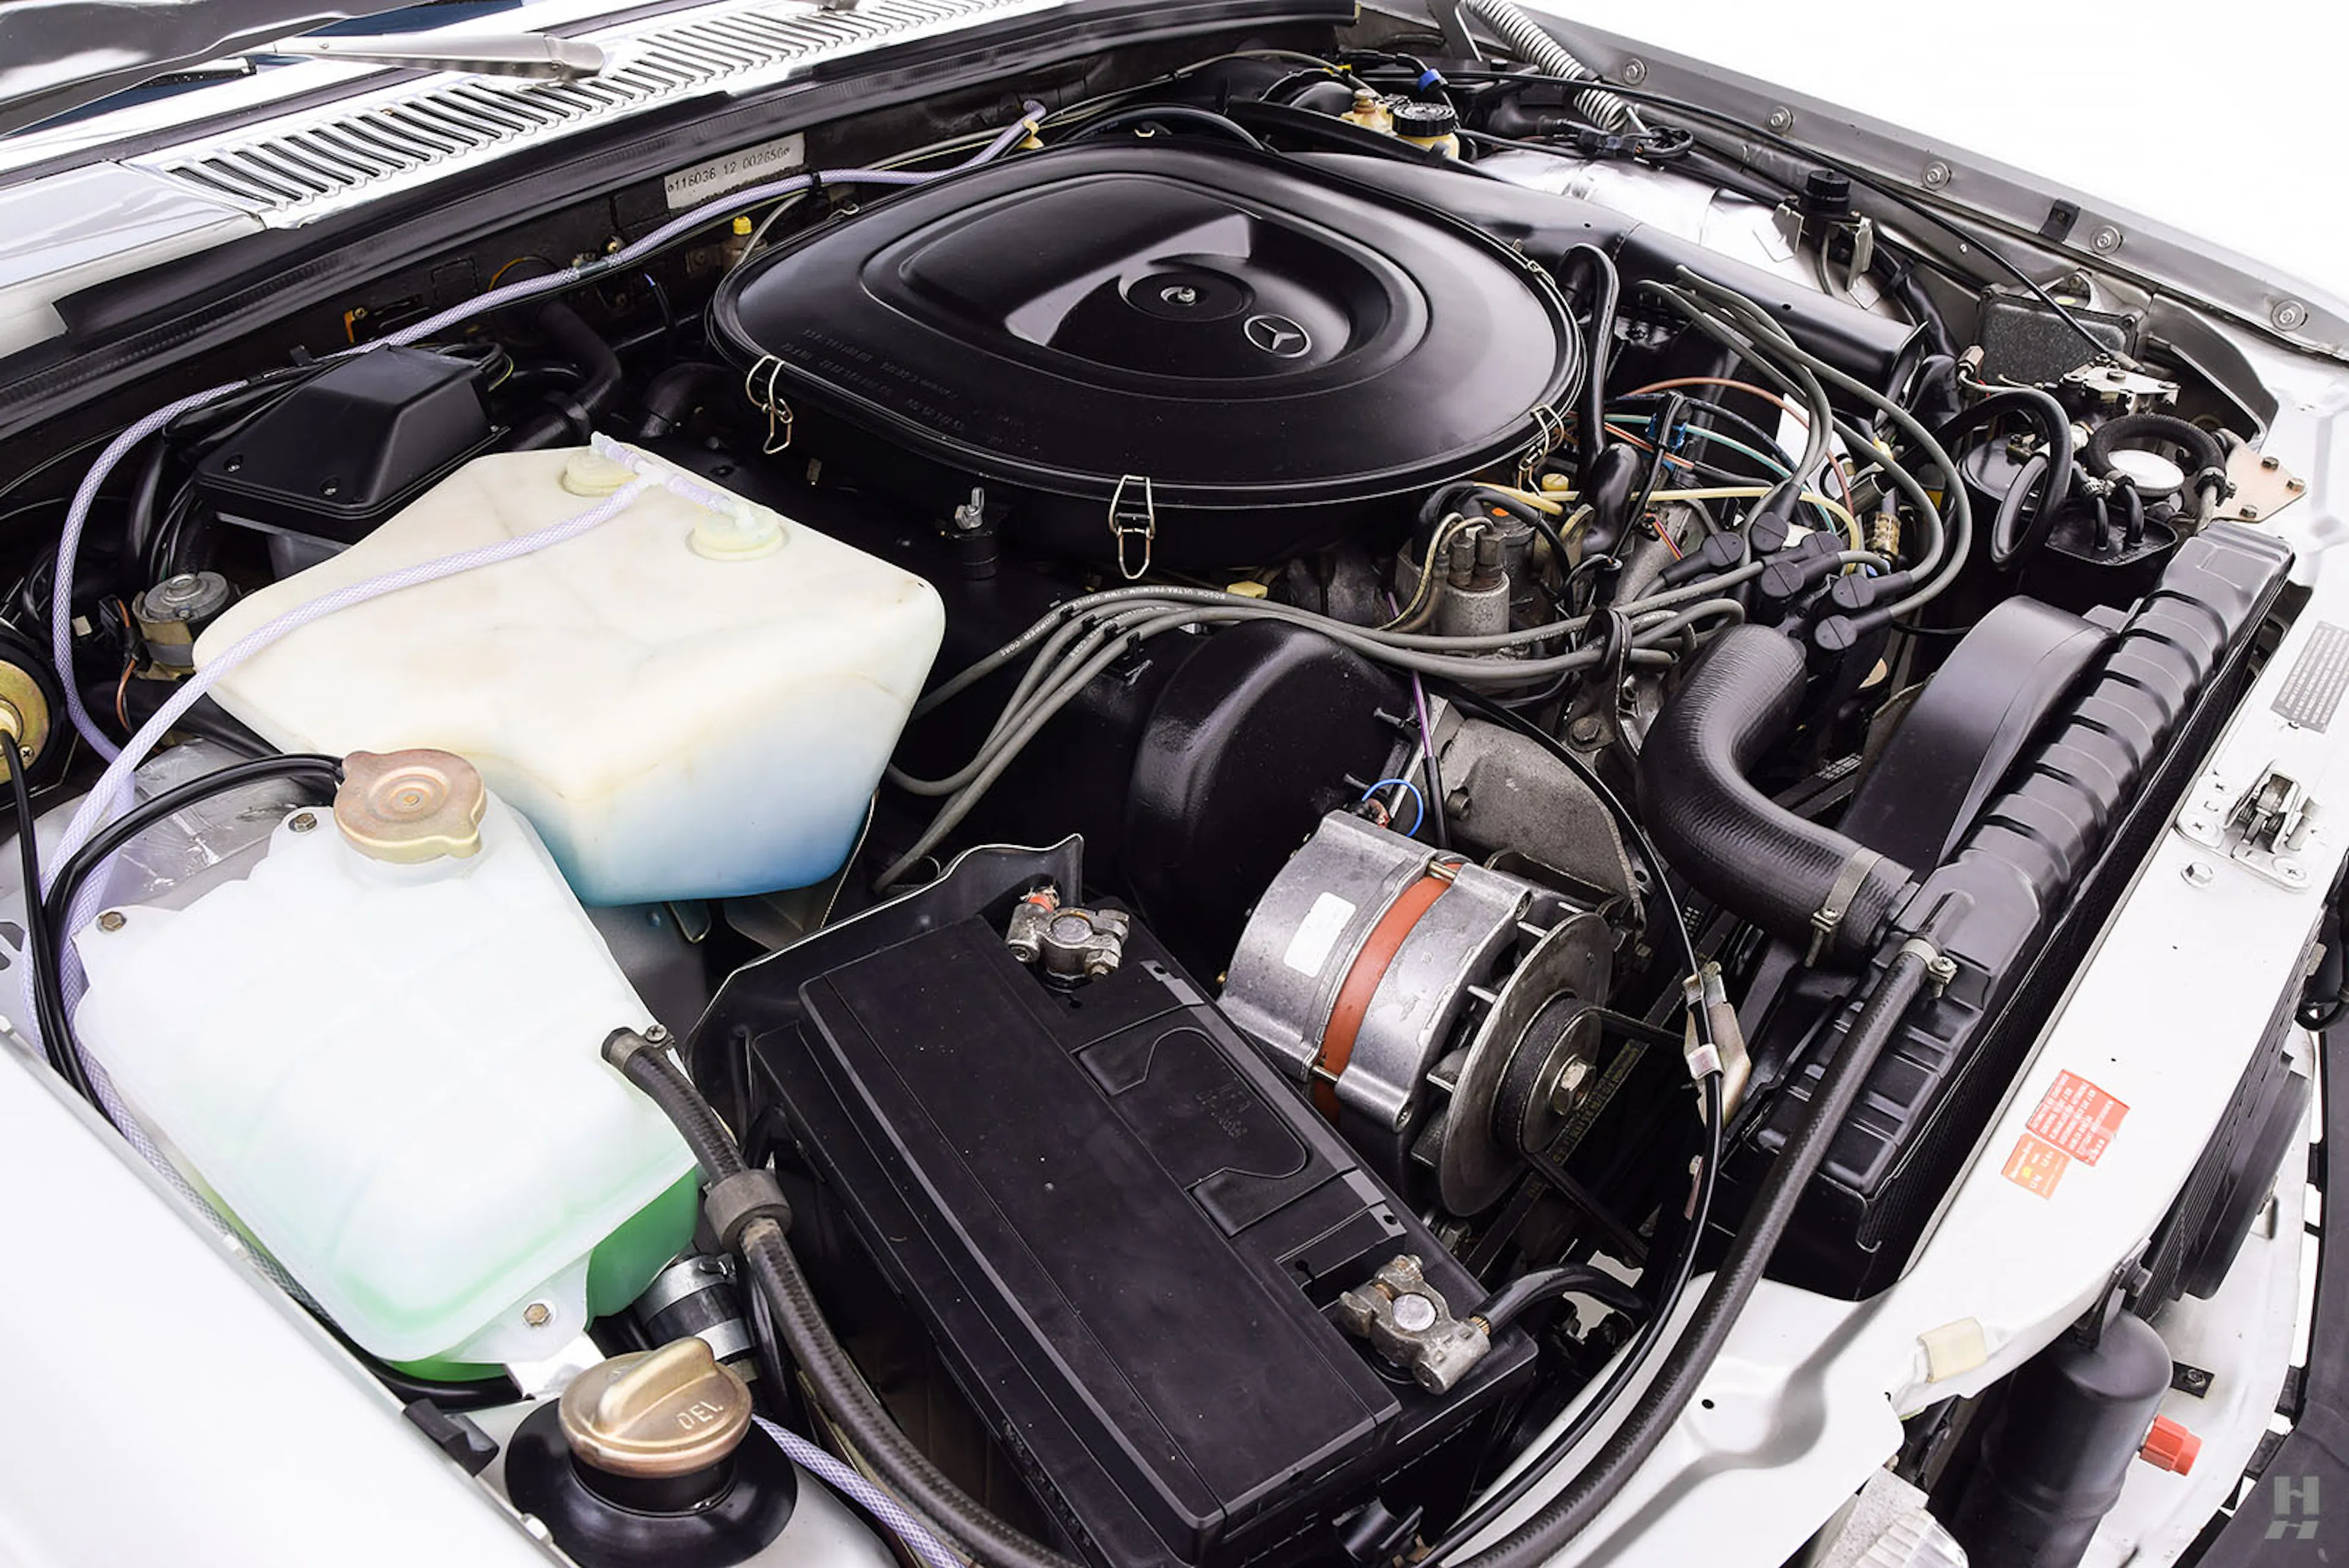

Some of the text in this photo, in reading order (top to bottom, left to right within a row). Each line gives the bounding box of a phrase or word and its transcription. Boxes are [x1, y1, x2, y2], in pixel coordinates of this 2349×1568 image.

[724, 162, 737, 175] 12
[1197, 589, 1225, 600] BOSCH
[676, 1400, 724, 1430] OEL
